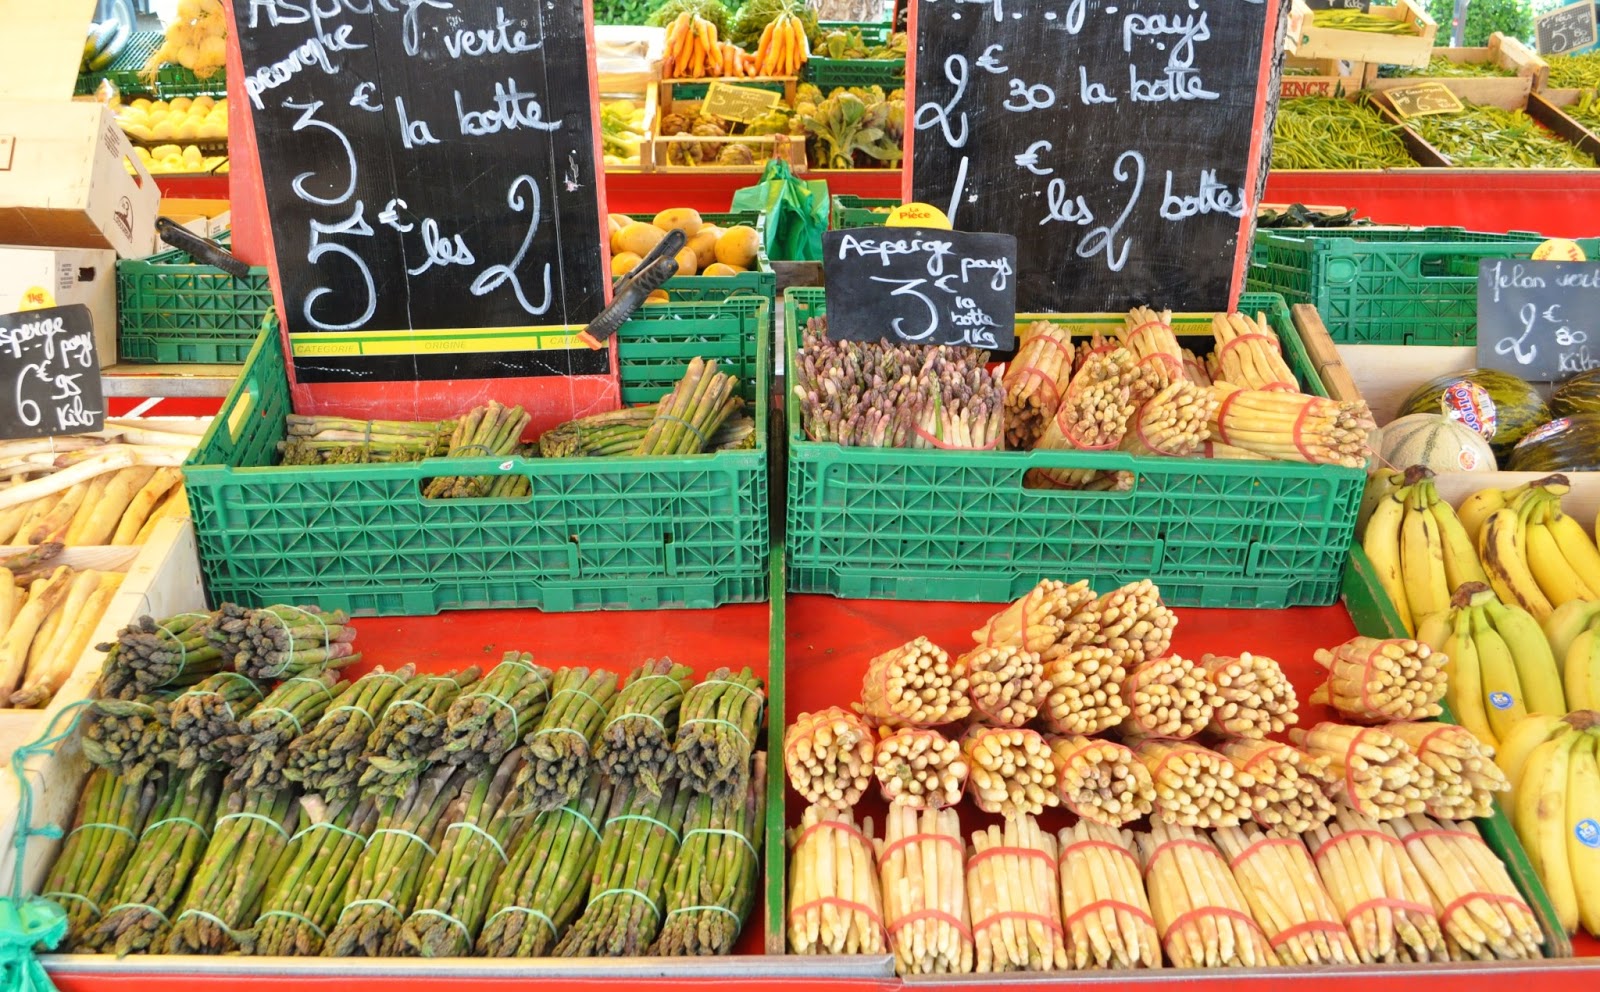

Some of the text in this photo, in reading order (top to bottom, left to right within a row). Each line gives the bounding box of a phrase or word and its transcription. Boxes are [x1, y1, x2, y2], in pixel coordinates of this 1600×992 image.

[444, 7, 543, 59] verte
[1124, 11, 1210, 67] pays
[1551, 24, 1567, 52] 5
[1079, 65, 1118, 106] la
[1129, 63, 1220, 102] botte
[1281, 81, 1330, 97] ENCE
[395, 96, 441, 149] la
[454, 77, 562, 137] botte
[1039, 178, 1095, 226] les
[1076, 150, 1147, 273] 2
[1160, 168, 1250, 221] bottes
[407, 217, 476, 276] les
[469, 173, 551, 316] 2
[838, 234, 1013, 292] Asperge pays
[951, 308, 1003, 328] botte
[955, 296, 976, 309] la
[0, 317, 67, 359] sperge
[296, 337, 583, 353] CATEGORIE ORIGINE CALIB
[1058, 322, 1209, 333] GINE ALIBRE
[57, 395, 103, 430] Kilo
